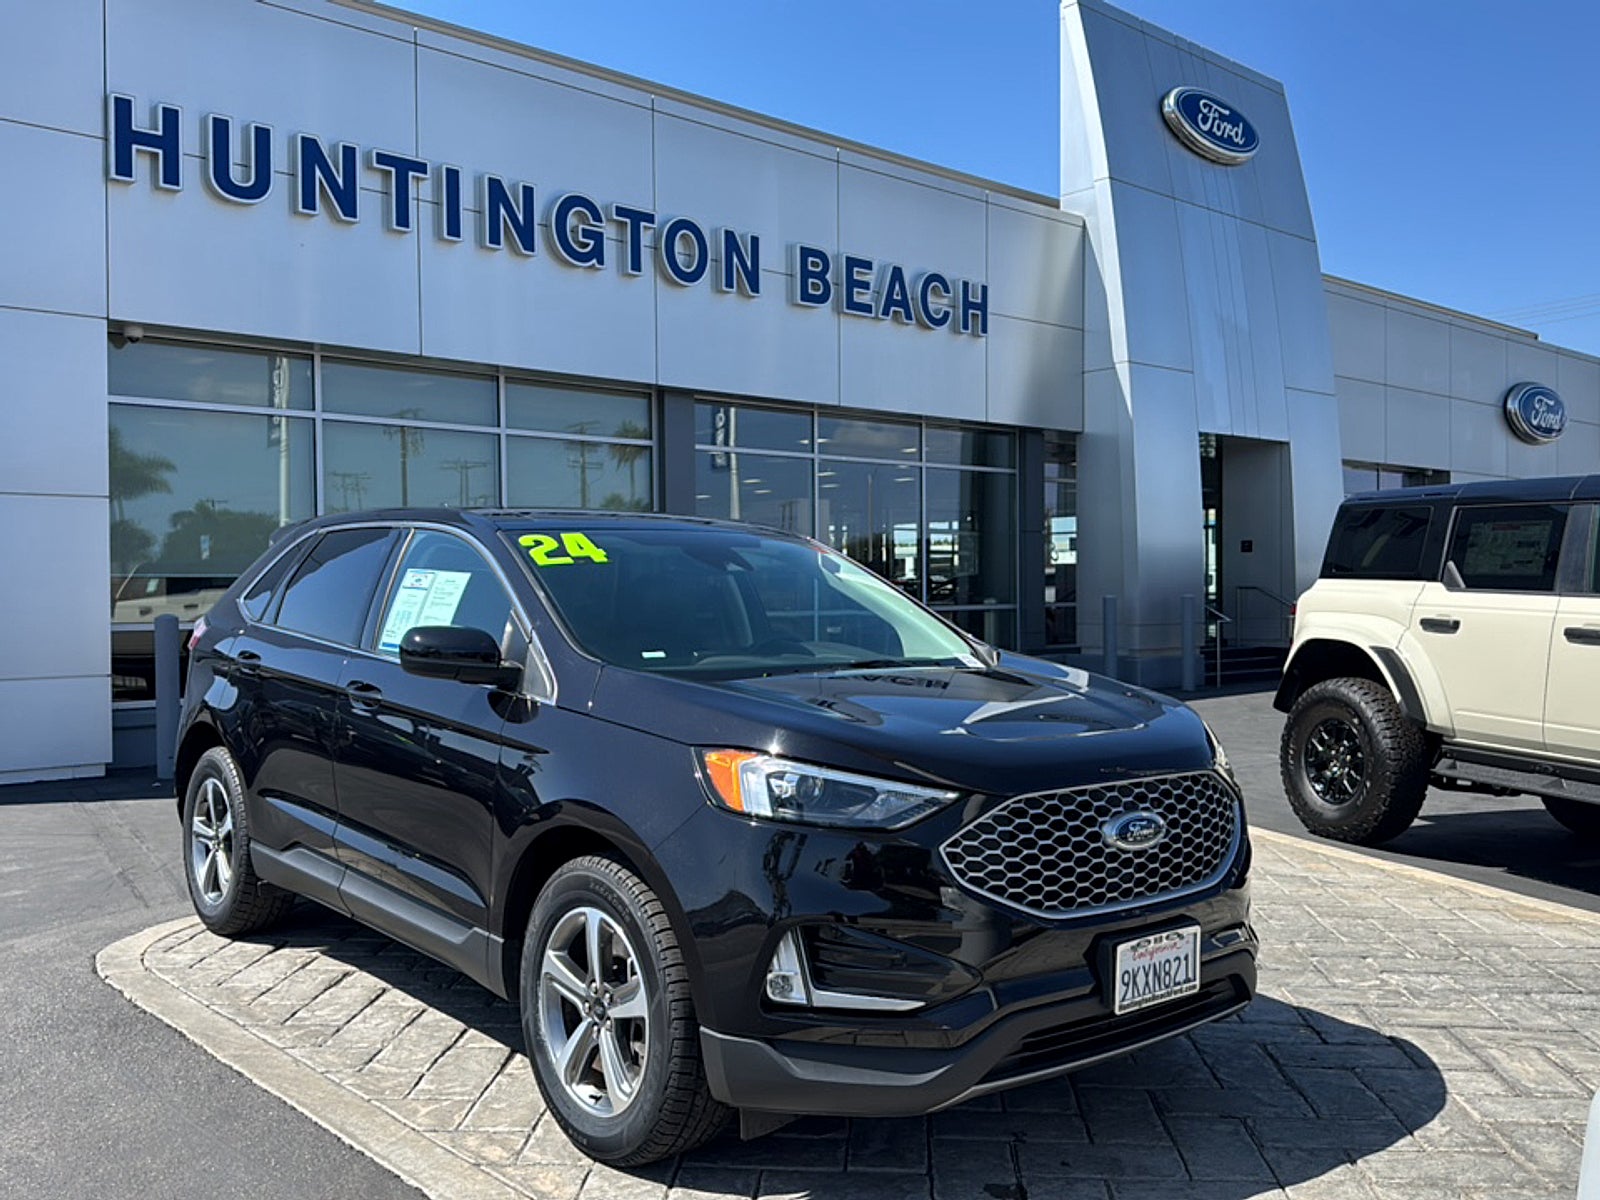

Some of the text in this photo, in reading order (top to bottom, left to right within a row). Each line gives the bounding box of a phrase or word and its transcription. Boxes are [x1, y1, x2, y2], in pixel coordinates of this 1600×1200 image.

[1197, 99, 1246, 145] Ford
[109, 93, 990, 336] HUNTINGTON BEACH
[1531, 395, 1562, 430] Ford
[518, 532, 609, 566] 24
[1126, 820, 1155, 842] Ford
[1121, 953, 1193, 1002] 9KXN821
